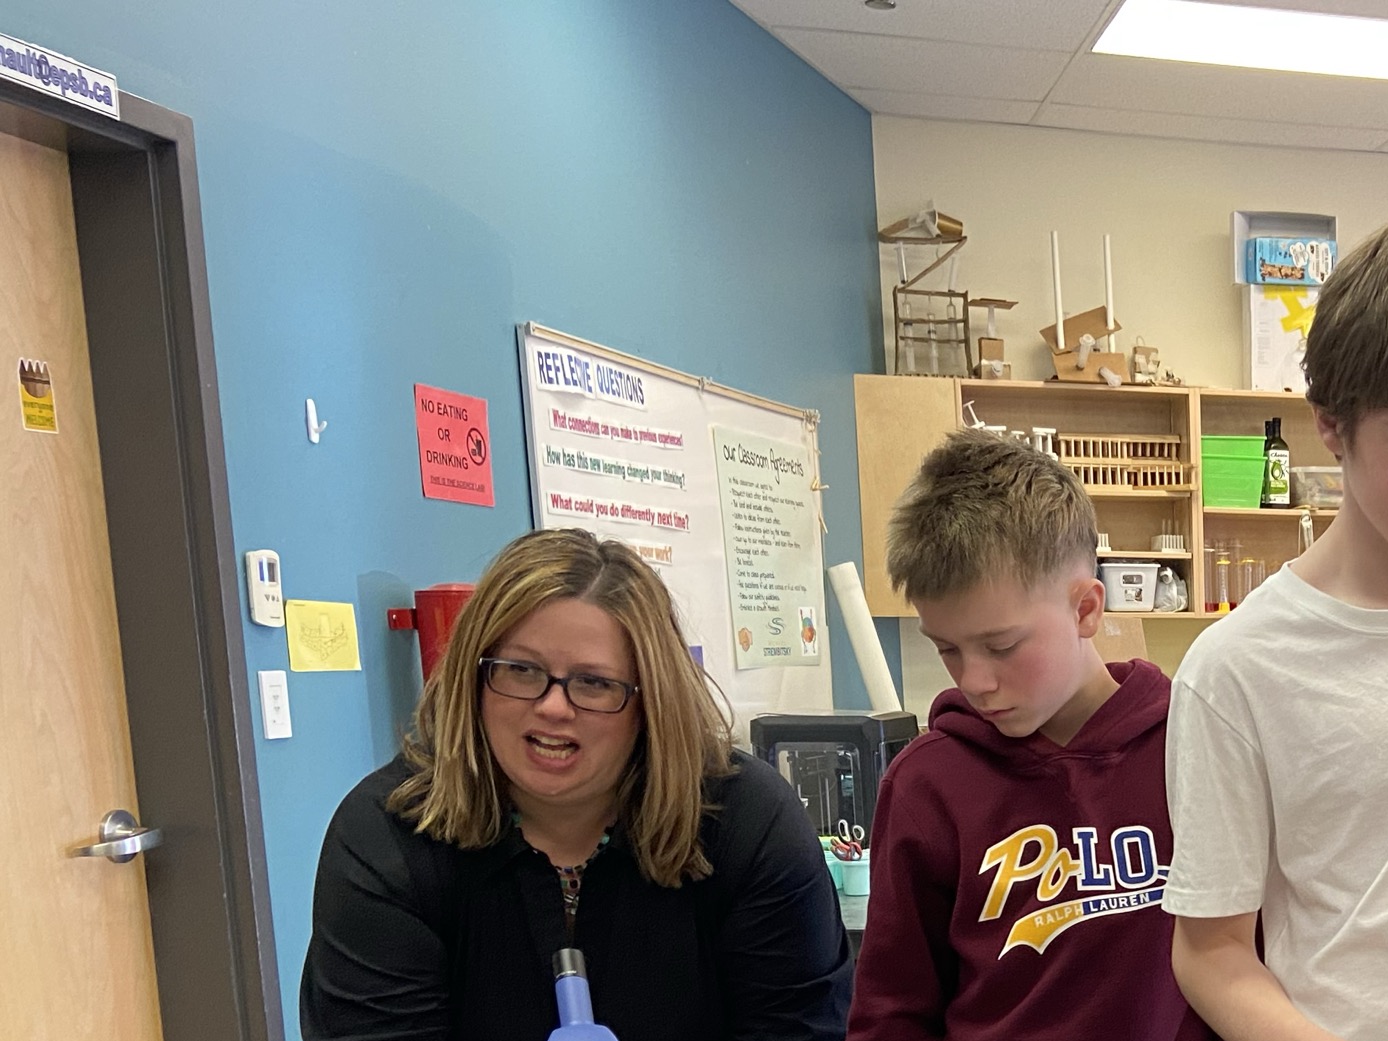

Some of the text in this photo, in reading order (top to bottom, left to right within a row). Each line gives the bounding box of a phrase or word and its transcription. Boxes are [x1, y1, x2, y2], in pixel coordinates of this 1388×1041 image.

[596, 364, 645, 405] QUESTIONS
[421, 398, 468, 422] NO EATING
[552, 408, 567, 429] What
[568, 416, 600, 435] connections
[601, 423, 609, 436] can
[610, 425, 620, 440] you
[620, 424, 632, 440] make
[438, 427, 451, 442] OR
[426, 450, 469, 470] DRINKING
[546, 445, 686, 488] How has this new learning changed your thinking?
[738, 443, 769, 470] Classroom
[769, 448, 804, 485] Agreements
[551, 493, 689, 530] What could you do differently next time?
[1034, 892, 1151, 928] RALPH LAUREN
